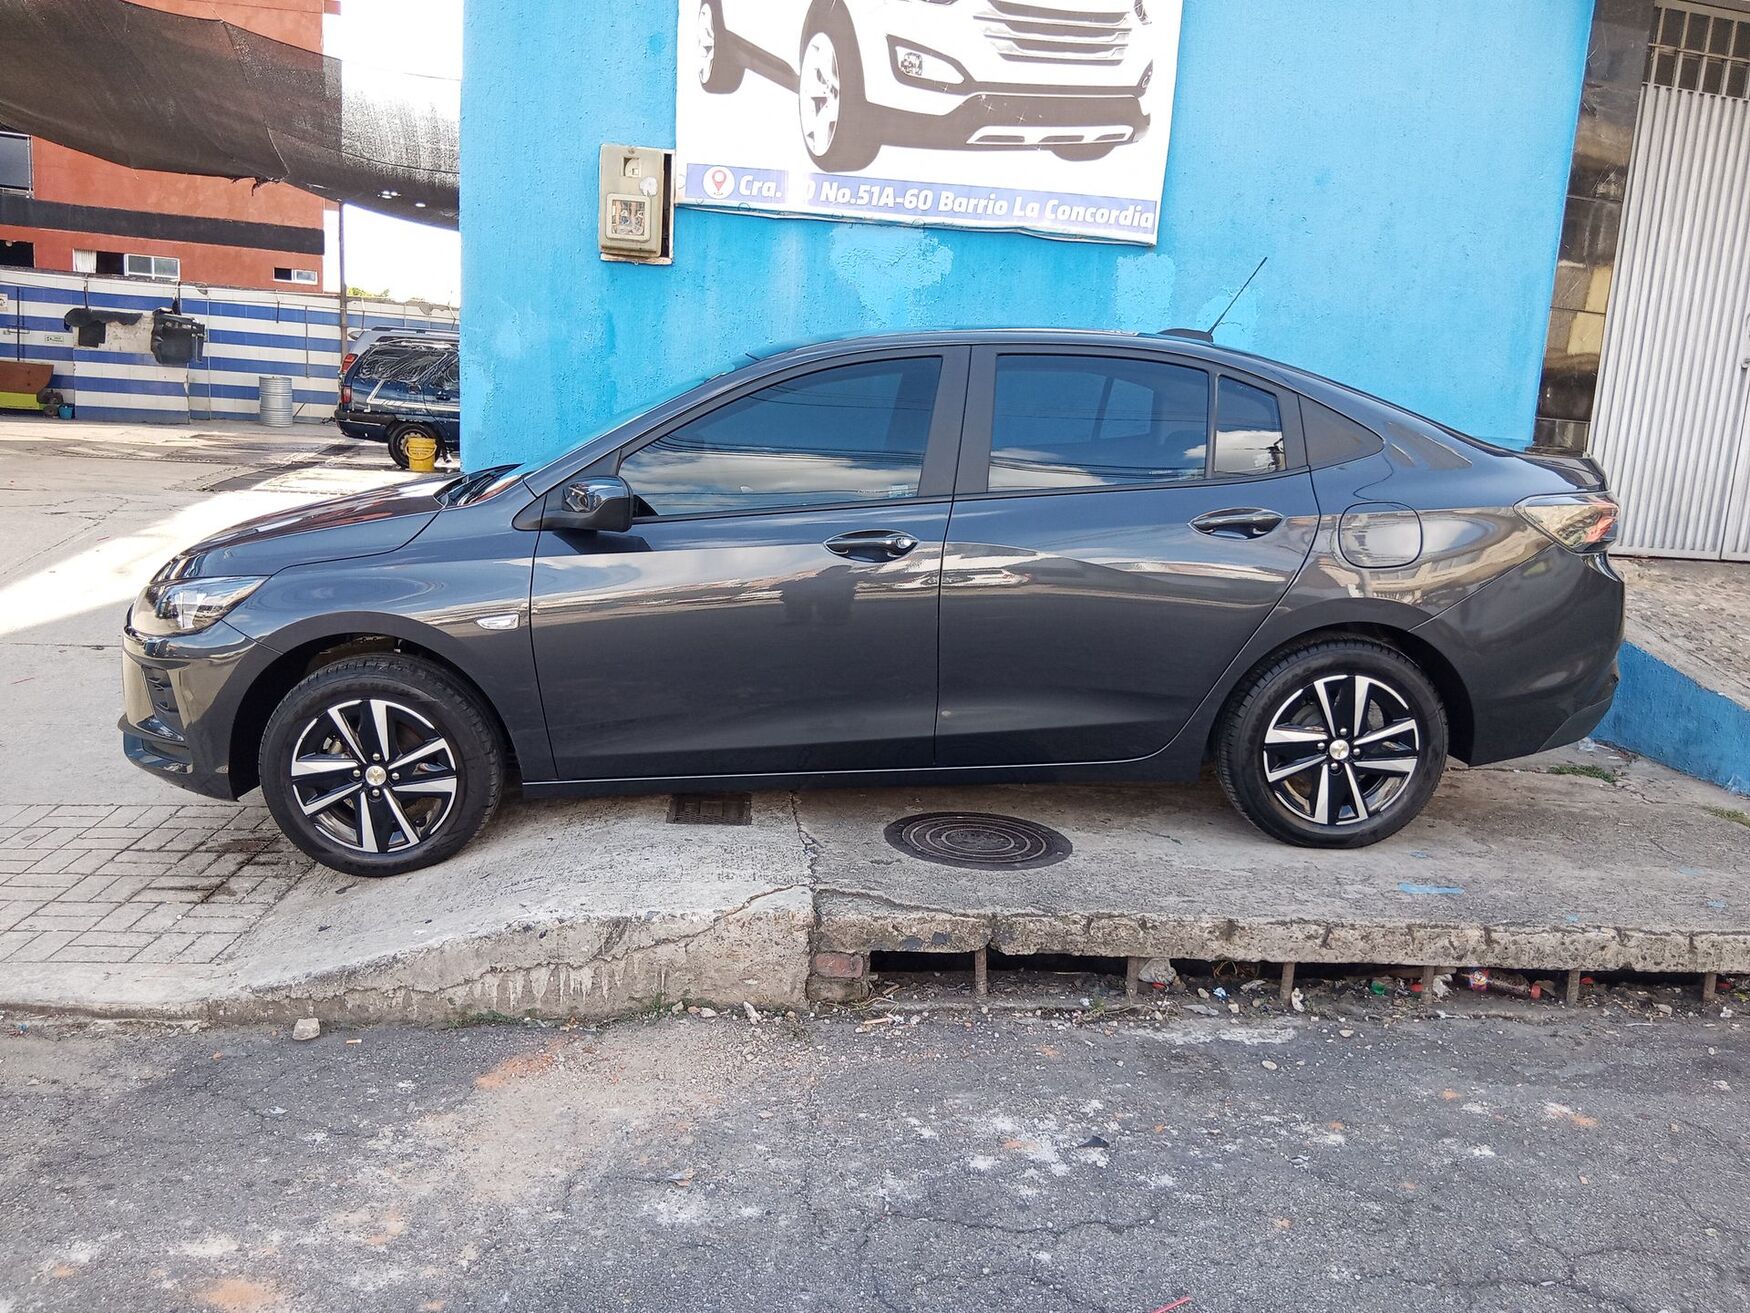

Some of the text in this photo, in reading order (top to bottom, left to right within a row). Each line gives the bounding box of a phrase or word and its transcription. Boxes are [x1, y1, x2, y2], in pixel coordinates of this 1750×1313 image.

[739, 175, 783, 198] Cra.
[820, 181, 933, 211] No.51A-60
[938, 191, 1009, 216] Barrio
[1012, 196, 1041, 218] La
[1044, 199, 1155, 228] Concordia
